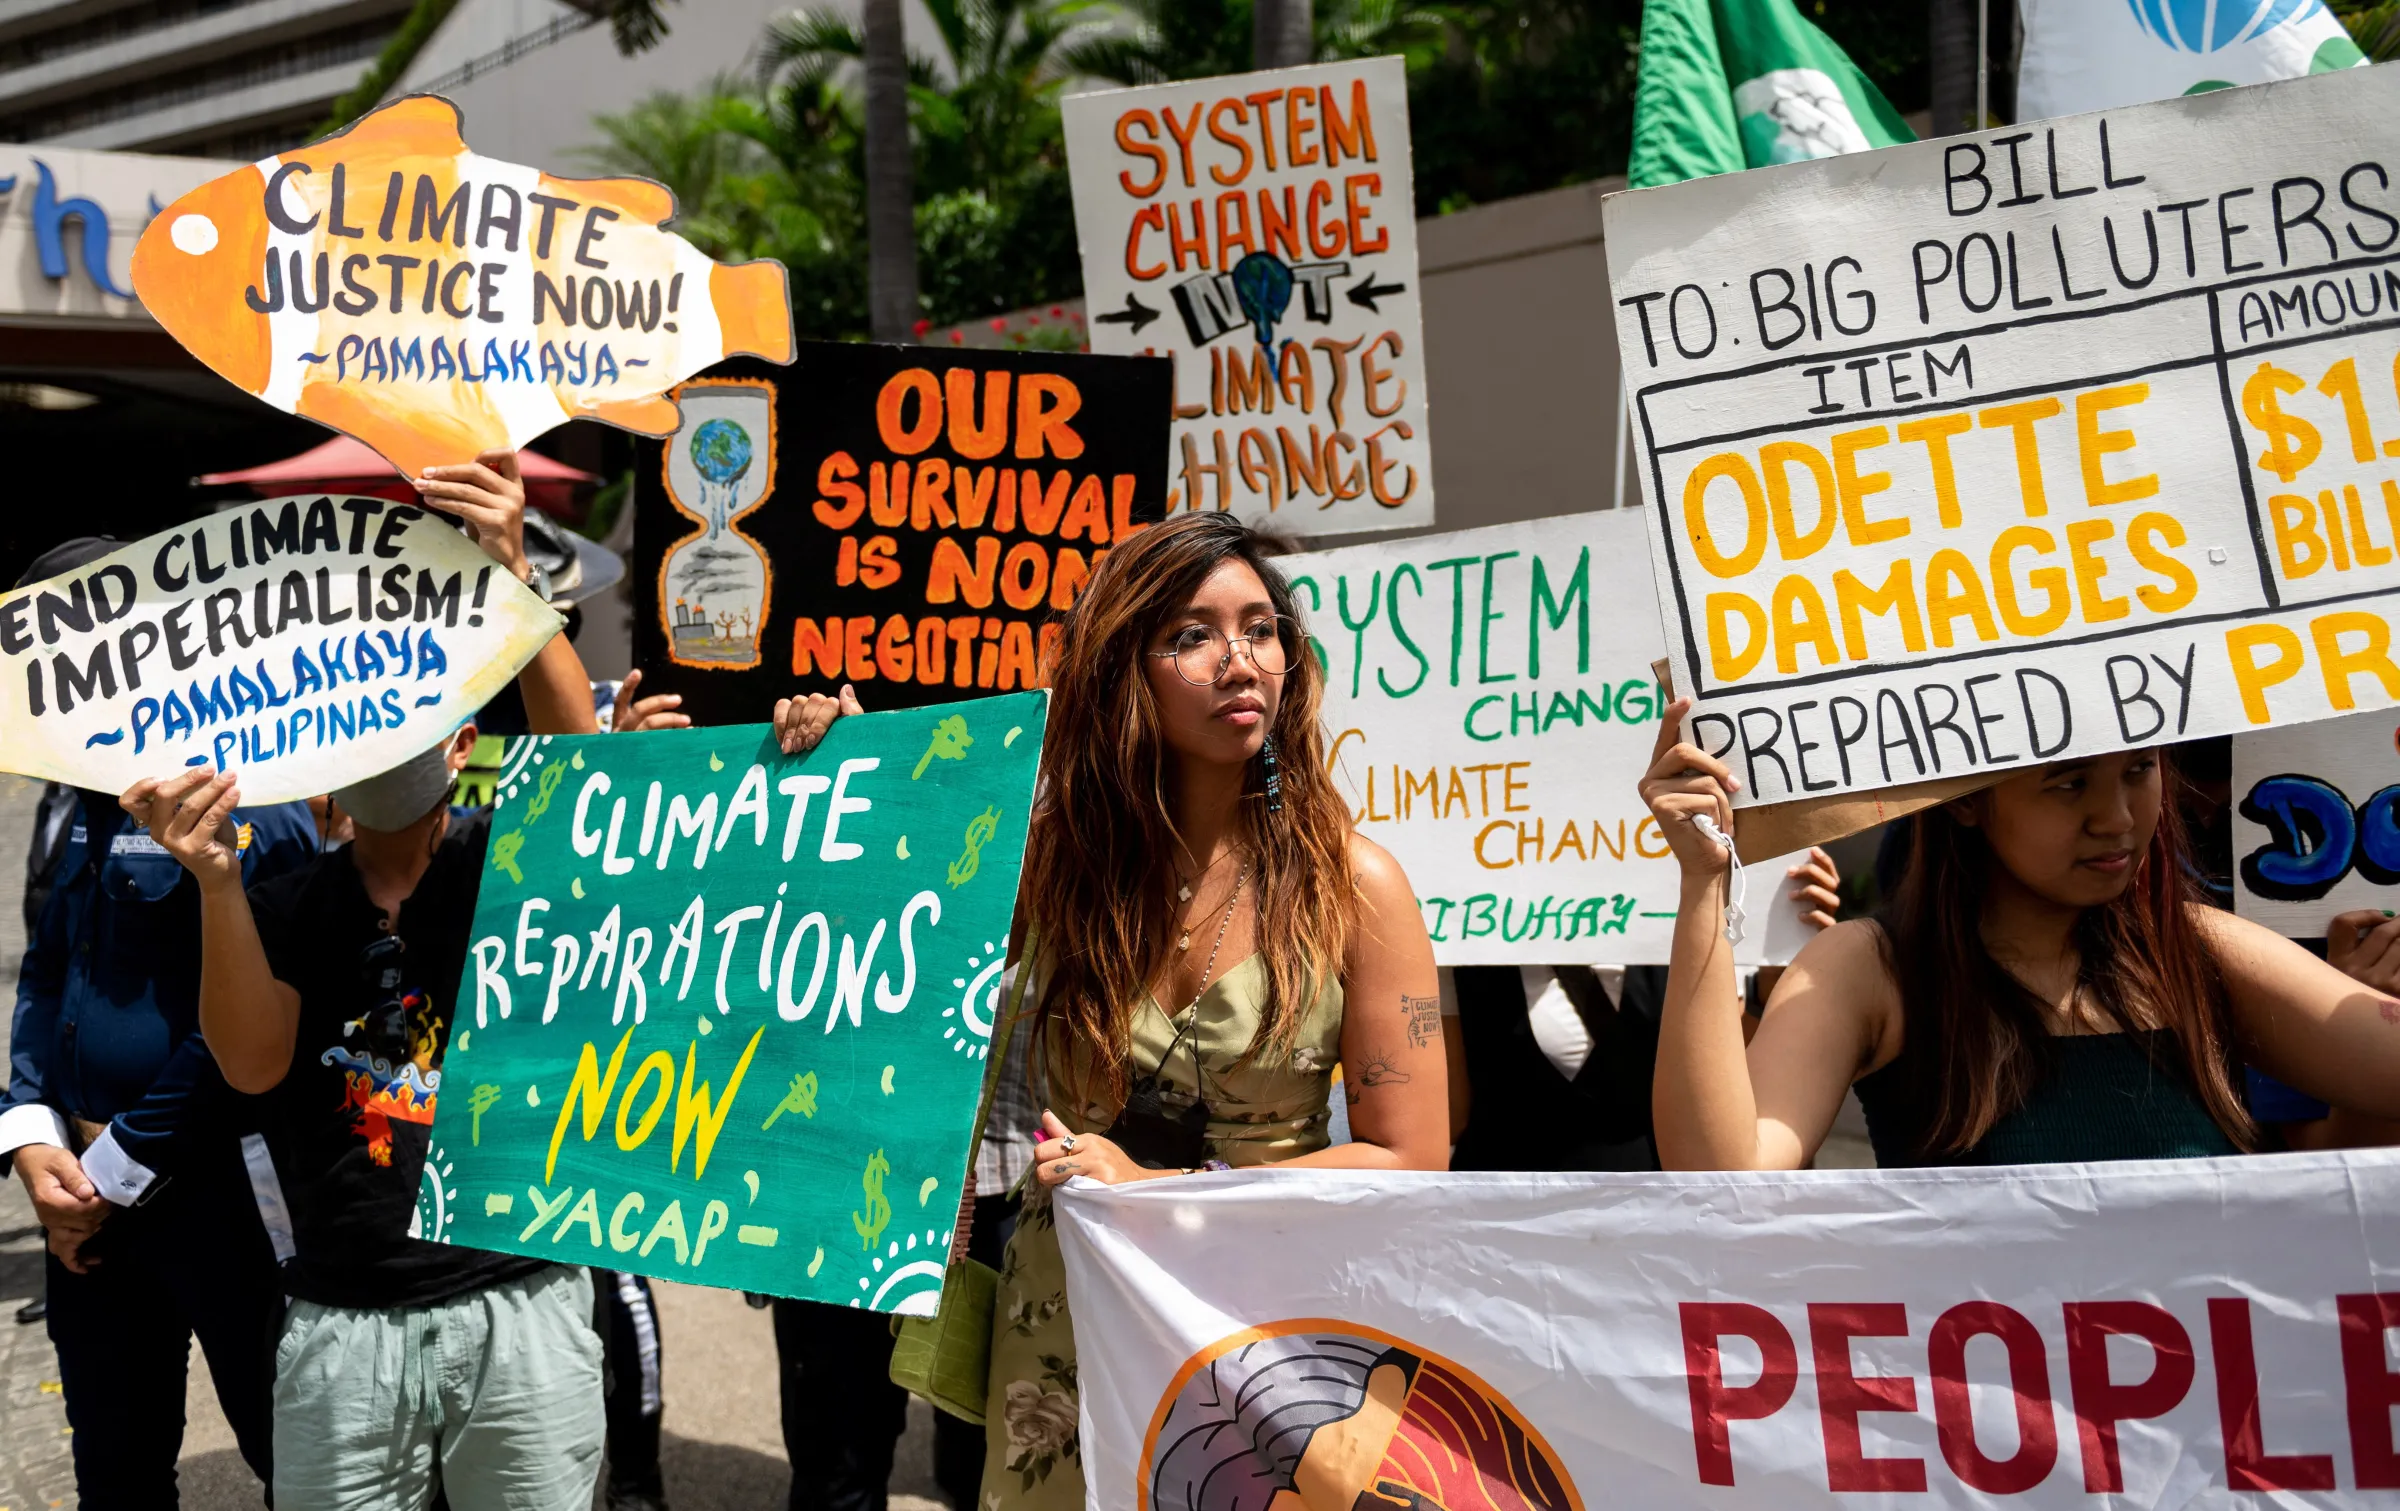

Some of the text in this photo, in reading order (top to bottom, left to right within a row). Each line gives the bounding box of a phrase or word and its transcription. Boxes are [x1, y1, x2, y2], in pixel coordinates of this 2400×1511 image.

[1115, 78, 1378, 198] SYSTEM
[1945, 118, 2147, 217] BILL
[264, 160, 620, 270] CLIMATE
[1125, 173, 1389, 281] CHANGE
[1750, 256, 1877, 351] BIG
[1914, 161, 2400, 324] POLLUTERS
[246, 246, 685, 334] JUSTICE NOW!
[876, 367, 1086, 460] OUR
[1132, 329, 1407, 431] LIMATE
[1803, 344, 1973, 414] ITEM
[812, 450, 1150, 543] SURVIVAL
[1167, 420, 1418, 513] HANGE
[1682, 382, 2160, 579] ODETTE
[0, 495, 425, 656] END CLIMATE
[836, 535, 902, 590] IS
[1706, 511, 2199, 683] DAMAGES
[27, 563, 493, 718] IMPERIALISM!
[1691, 667, 2073, 800] PREPARED
[2105, 642, 2195, 745] BY
[571, 757, 881, 876] CLIMATE
[545, 1024, 767, 1187] NOW
